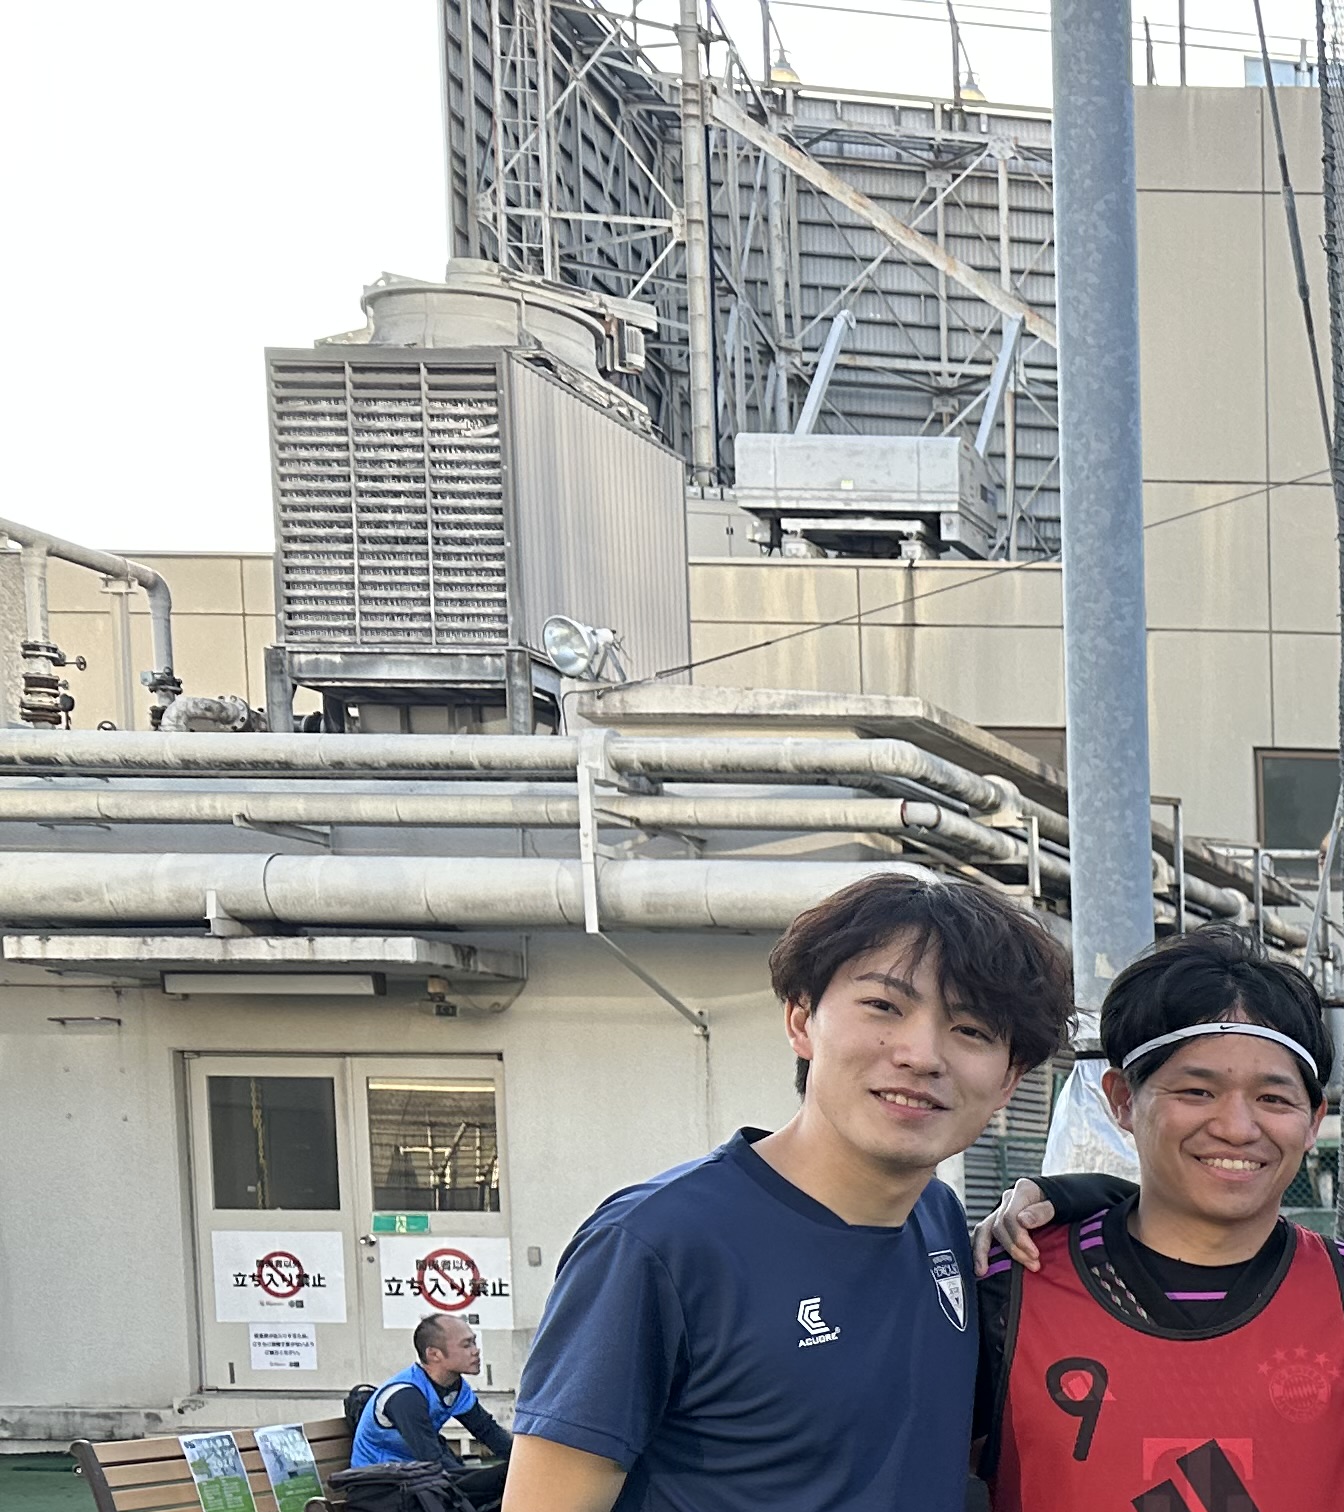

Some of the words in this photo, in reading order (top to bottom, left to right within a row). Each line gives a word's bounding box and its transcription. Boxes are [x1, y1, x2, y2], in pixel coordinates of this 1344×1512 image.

[233, 1272, 326, 1288] 立ち入り禁止
[384, 1276, 510, 1297] 立ち入り禁止
[1045, 1356, 1109, 1461] 9
